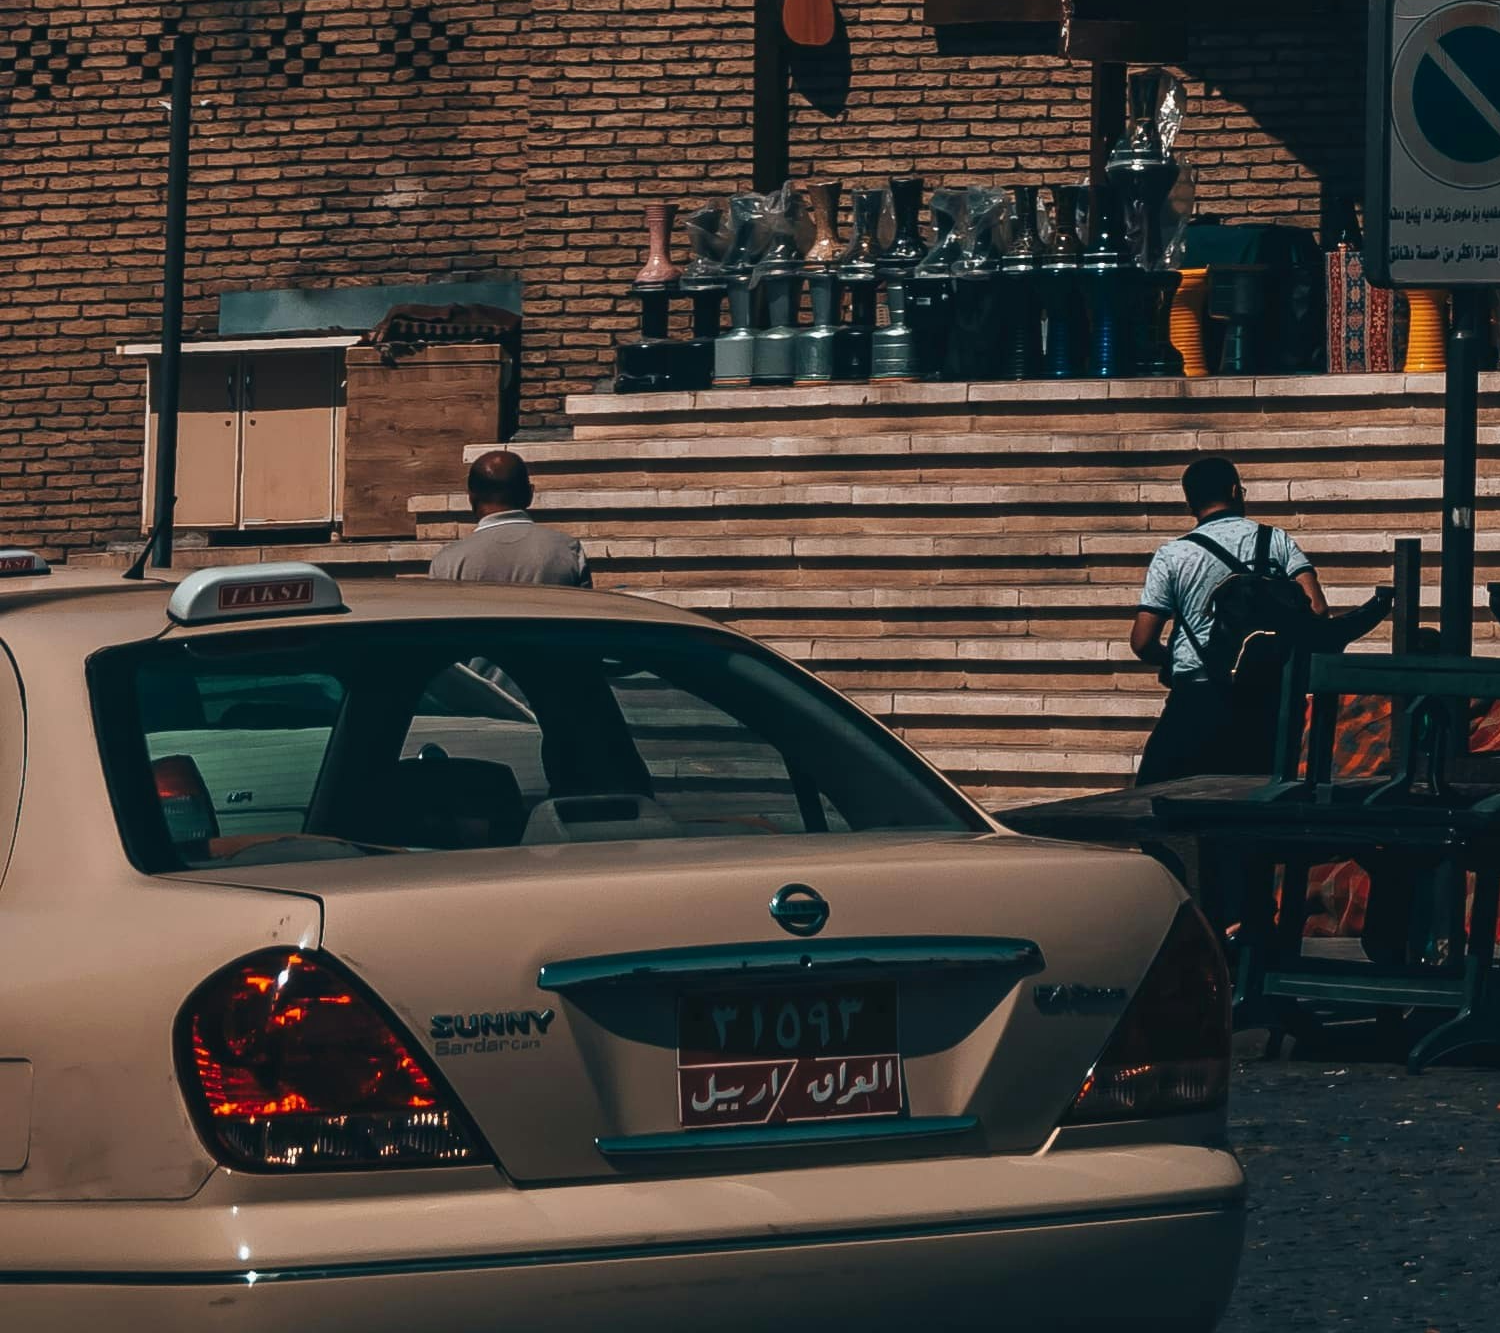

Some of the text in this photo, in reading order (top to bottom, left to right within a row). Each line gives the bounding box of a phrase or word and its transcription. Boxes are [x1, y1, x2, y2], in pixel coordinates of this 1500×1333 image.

[431, 1009, 555, 1038] SUNNY
[435, 1038, 509, 1056] Sardar
[807, 1059, 893, 1106] العراق
